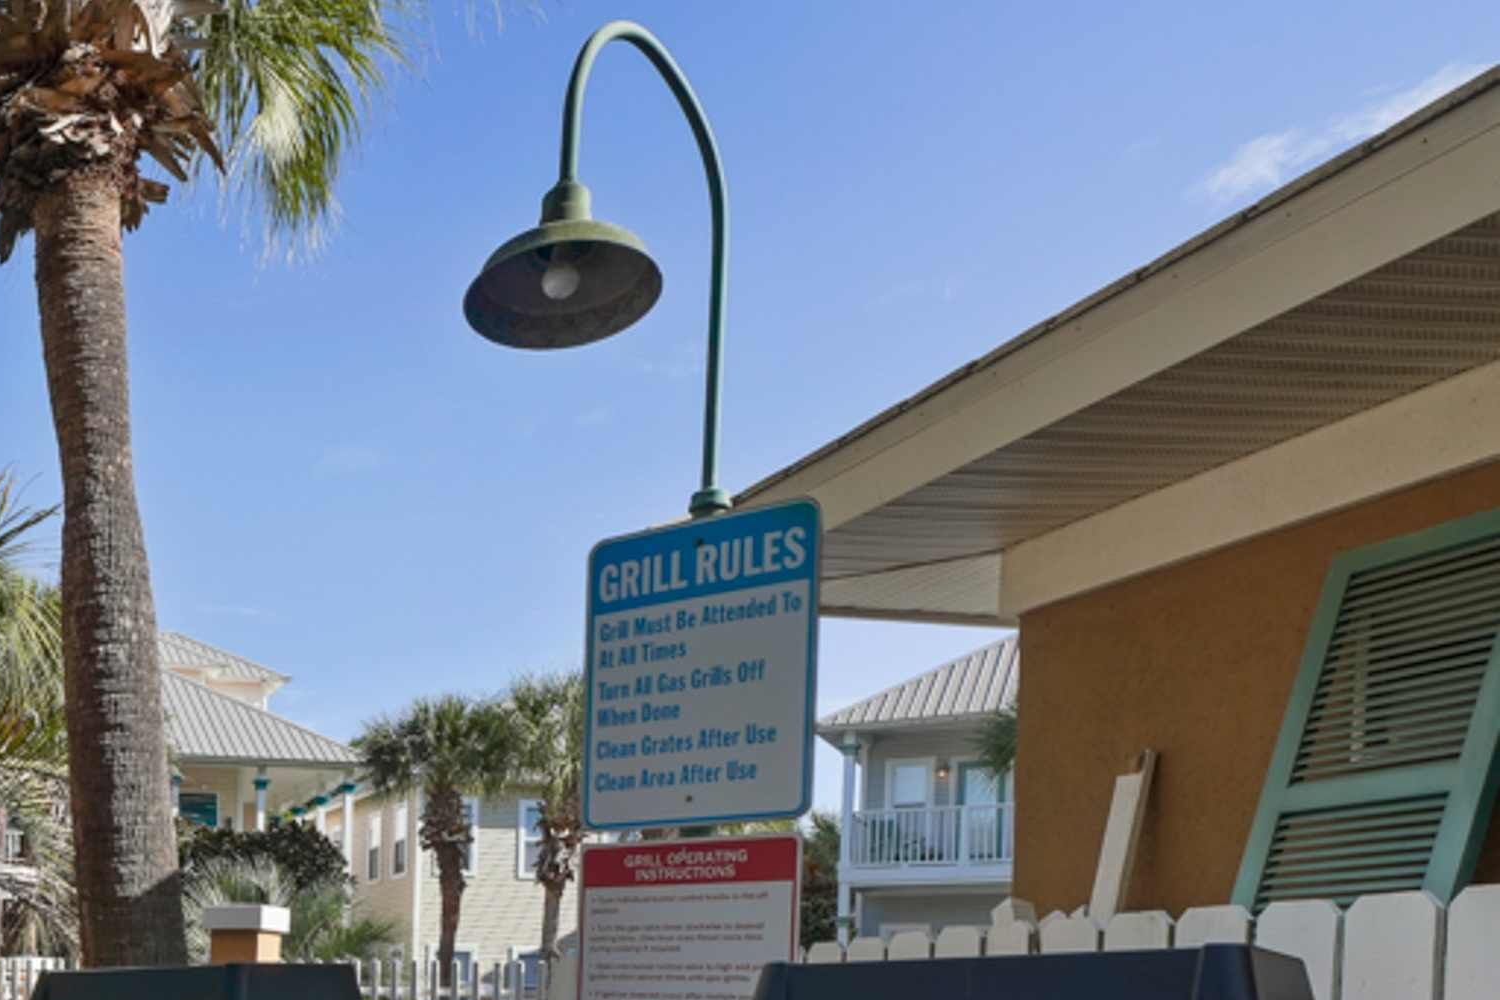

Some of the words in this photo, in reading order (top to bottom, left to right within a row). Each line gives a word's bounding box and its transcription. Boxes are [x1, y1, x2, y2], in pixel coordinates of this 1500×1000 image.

[599, 550, 687, 604] GRILL
[696, 526, 806, 585] RULES
[601, 618, 629, 642] Grill
[633, 613, 672, 637] Must
[676, 609, 696, 630] Be
[701, 597, 777, 628] Attended
[782, 591, 802, 613] To
[601, 648, 614, 669] At
[618, 645, 636, 666] All
[642, 640, 687, 663] Times
[599, 680, 629, 700] Turn
[635, 675, 653, 696] All
[657, 672, 687, 693] Gas
[690, 666, 732, 689] Grills
[738, 660, 766, 683] Off
[597, 706, 636, 727] When
[641, 702, 681, 722] Done
[597, 739, 636, 760] Clean
[642, 733, 693, 756] Grates
[697, 727, 741, 750] After
[746, 724, 777, 744] Use
[595, 771, 636, 792] Clean
[640, 766, 675, 788] Area
[680, 764, 721, 785] After
[726, 761, 757, 780] Use
[624, 854, 661, 868] GRILL
[667, 849, 748, 865] OPERATING
[635, 865, 736, 881] INSTRUCTIONS
